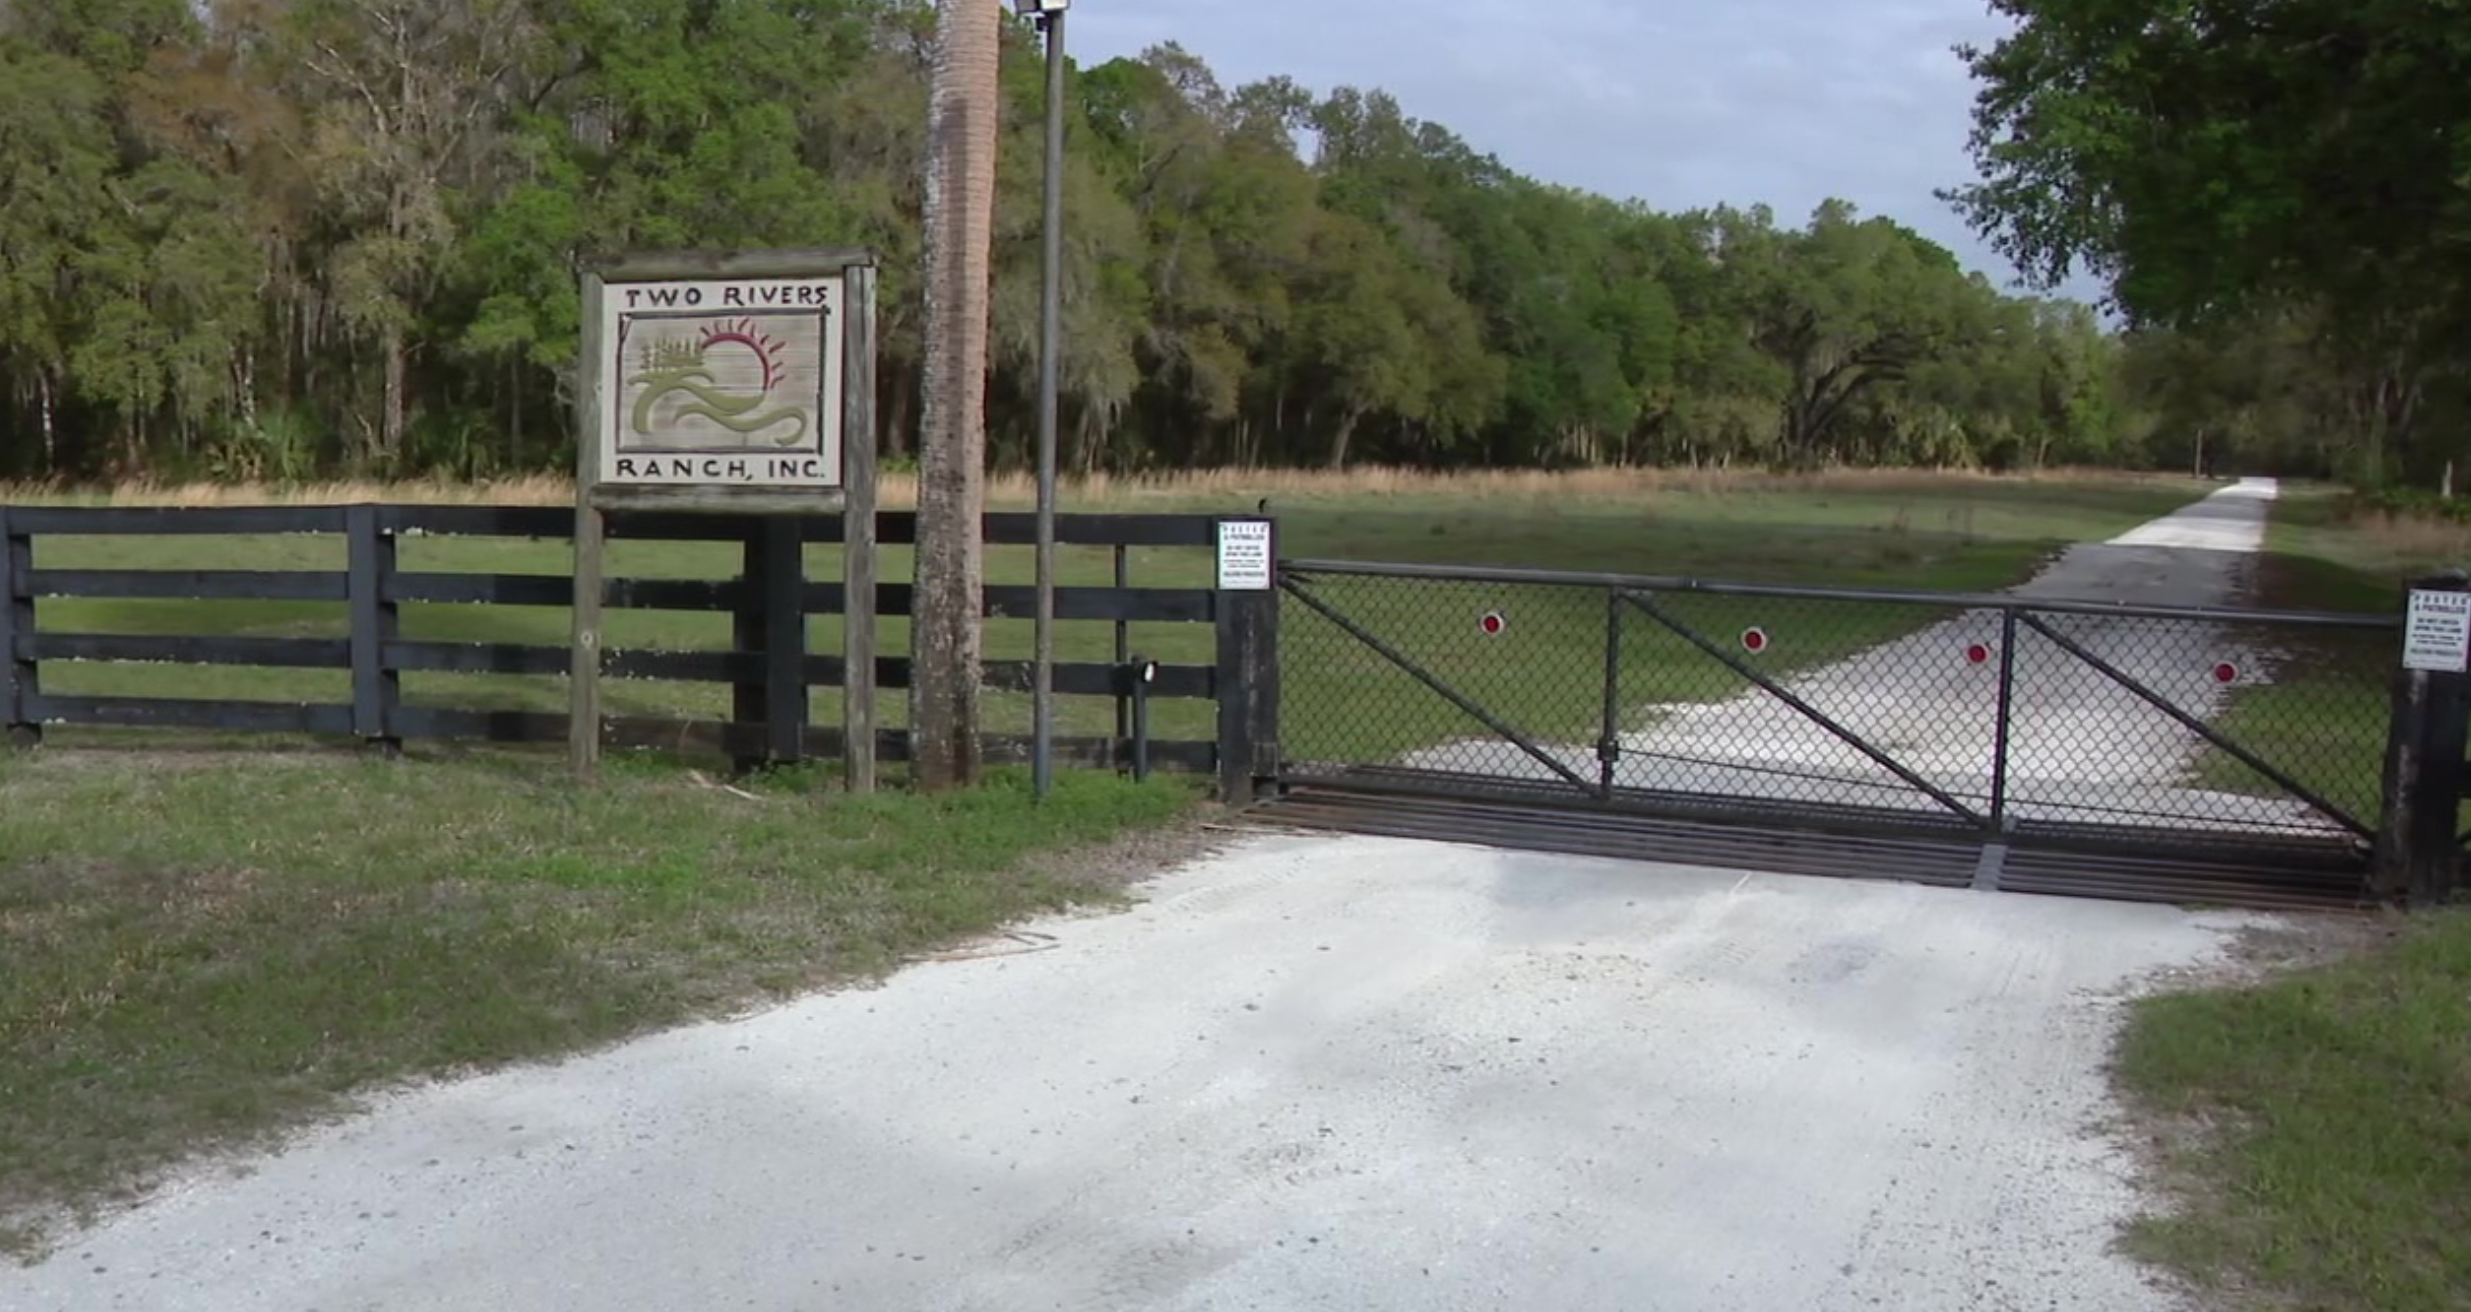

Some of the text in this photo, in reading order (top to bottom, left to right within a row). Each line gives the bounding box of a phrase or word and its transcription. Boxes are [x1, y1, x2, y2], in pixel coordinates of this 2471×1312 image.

[625, 286, 829, 307] TWO RIVERS
[616, 459, 825, 481] RANCH, INC.
